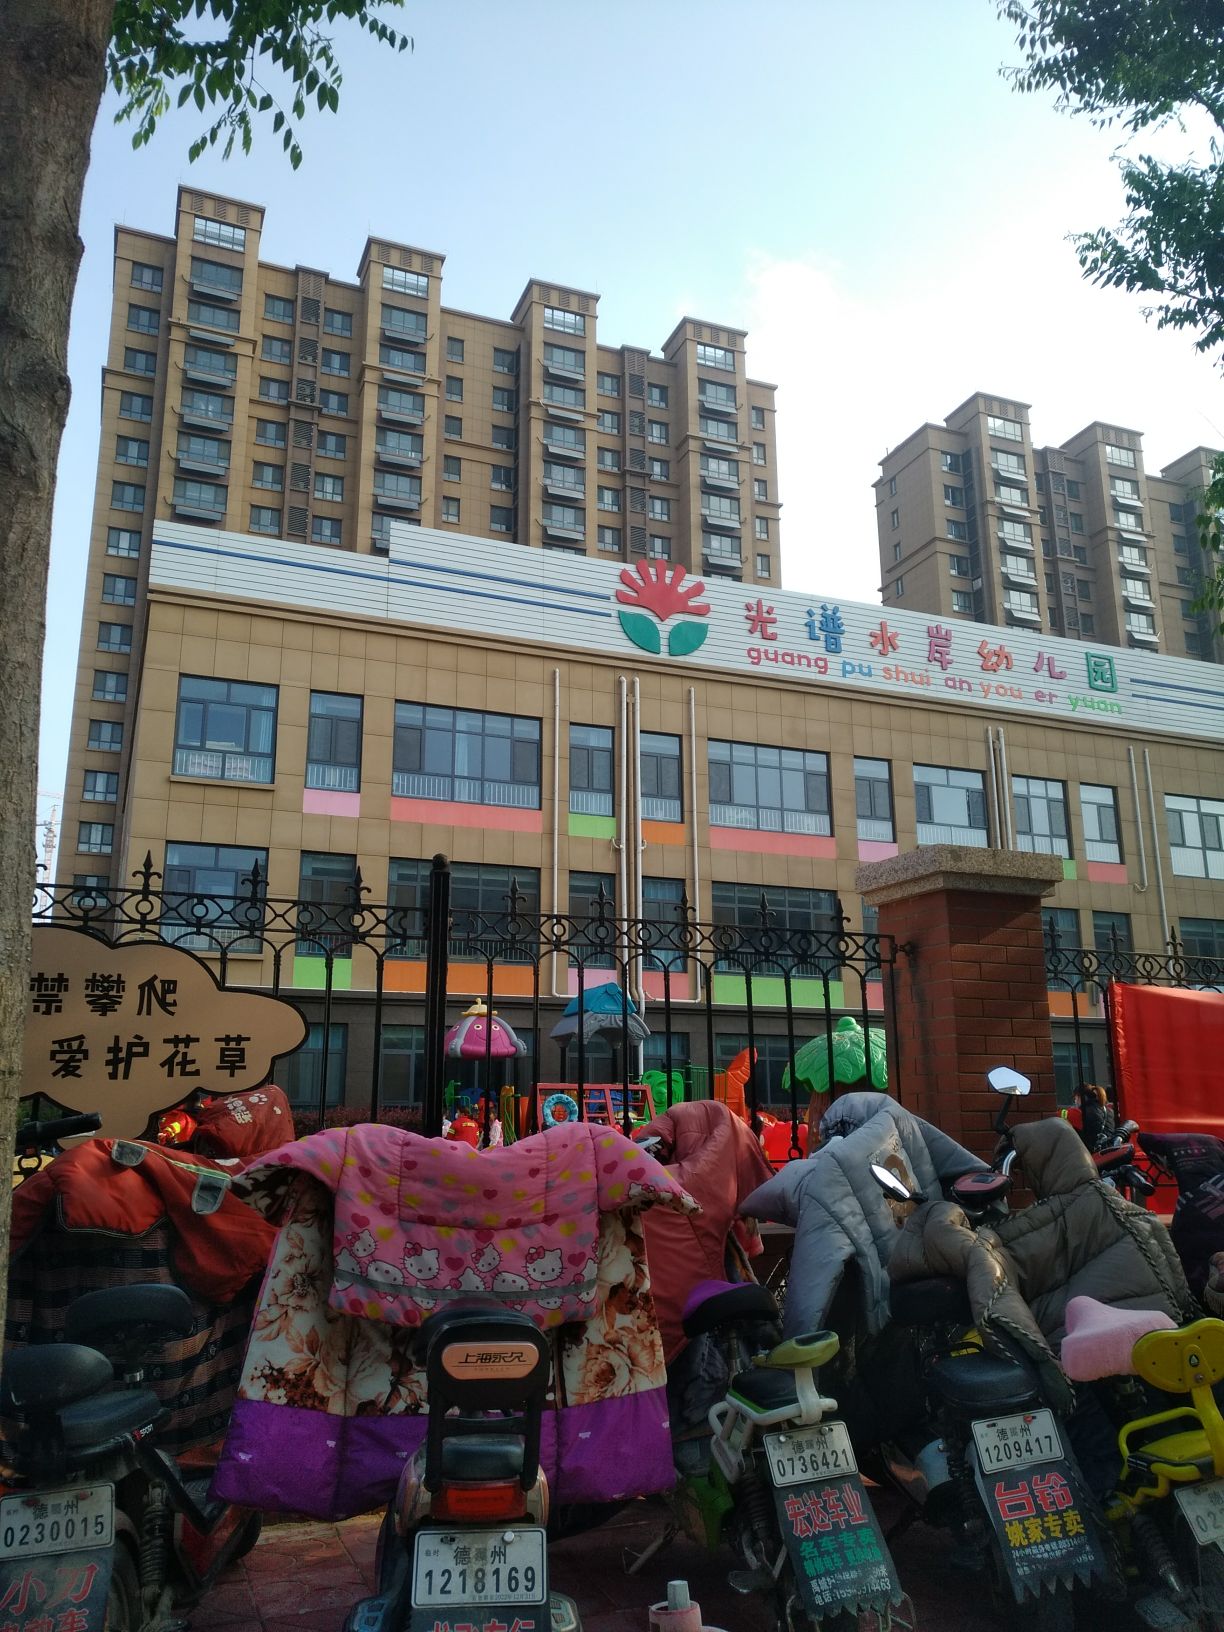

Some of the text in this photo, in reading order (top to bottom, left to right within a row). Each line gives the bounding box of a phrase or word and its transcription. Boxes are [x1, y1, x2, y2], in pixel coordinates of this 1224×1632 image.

[745, 598, 1119, 692] 光谱水岸幼儿园
[746, 647, 1123, 714] guang pu shui an you er yuan
[29, 972, 178, 1017] 禁攀爬
[50, 1033, 251, 1081] 爱护花草
[776, 1448, 850, 1478] 0736421
[985, 1435, 1053, 1464] 1209417
[784, 1482, 869, 1538] 宏达车业
[994, 1472, 1074, 1521] 台铃
[4, 1514, 105, 1547] 0230015
[453, 1545, 507, 1566] 德州
[0, 1562, 99, 1616] 小刀
[424, 1566, 536, 1595] 1218169
